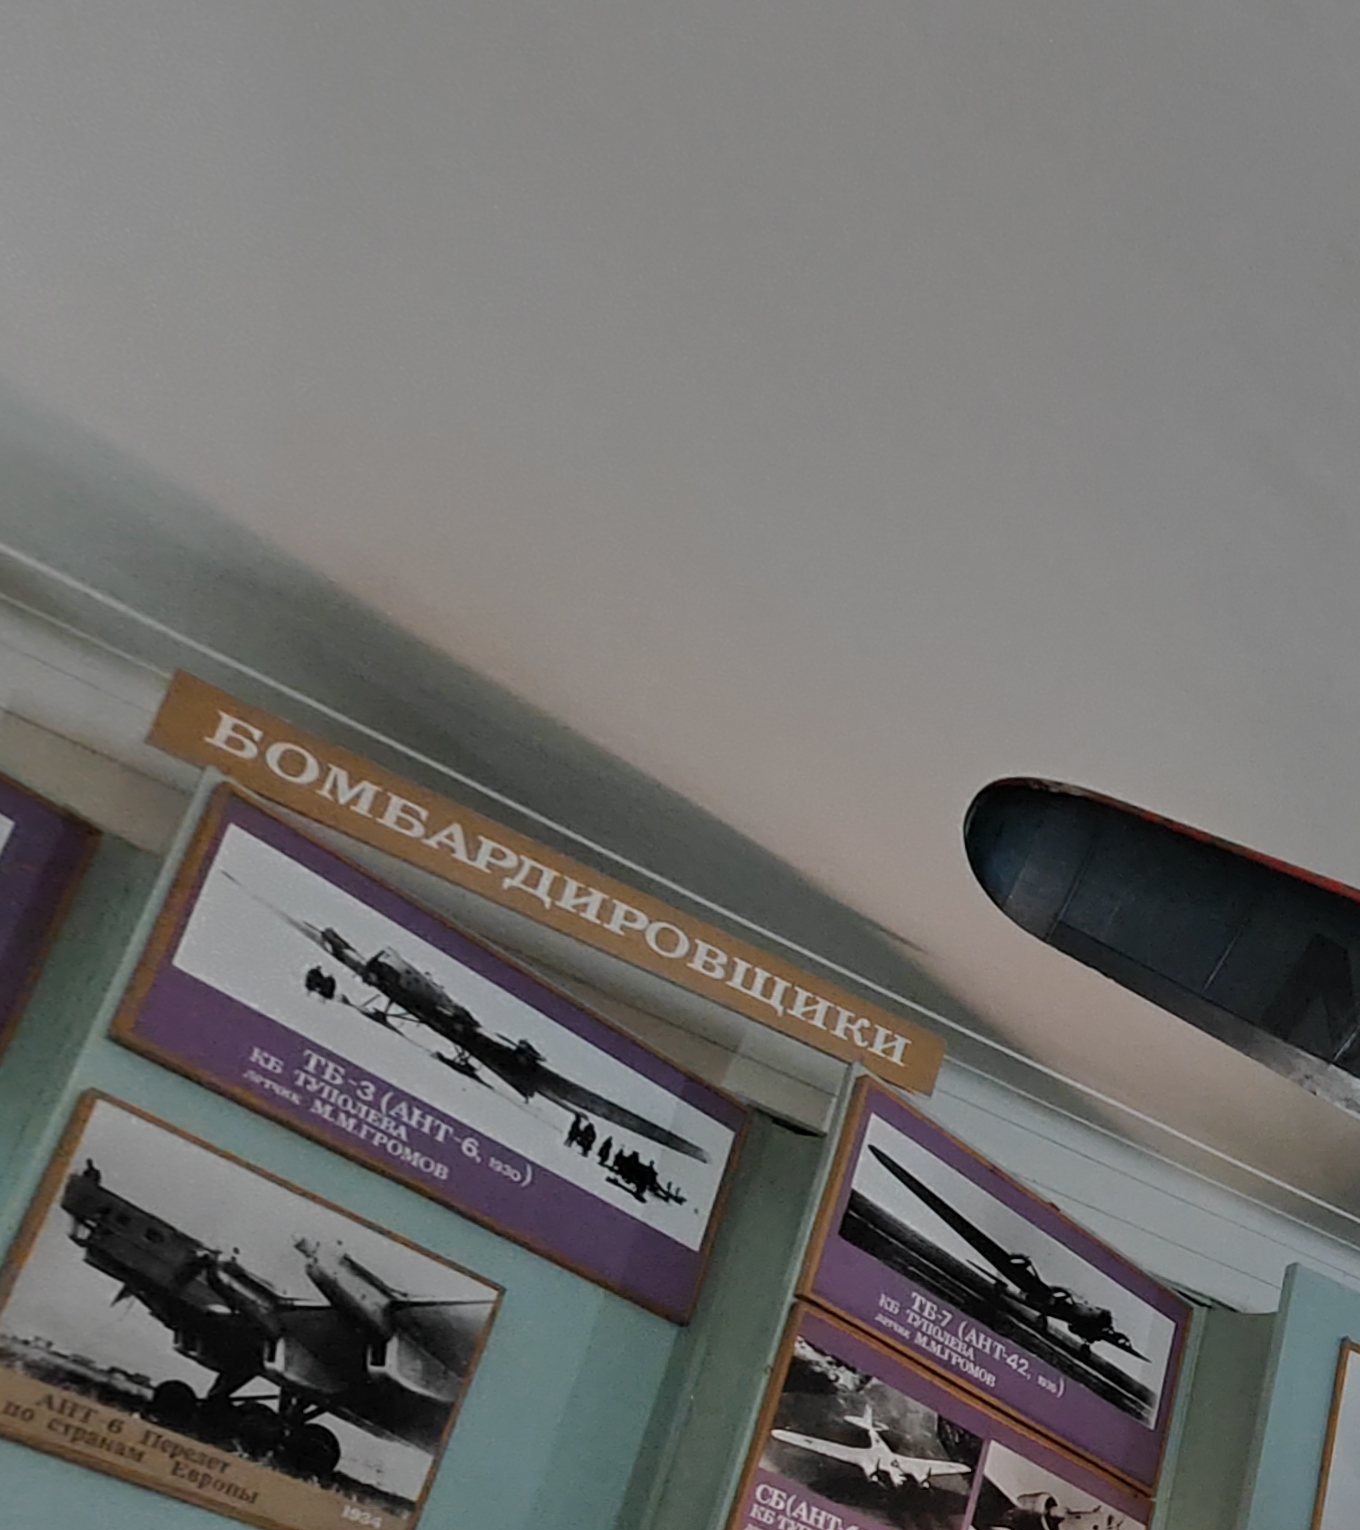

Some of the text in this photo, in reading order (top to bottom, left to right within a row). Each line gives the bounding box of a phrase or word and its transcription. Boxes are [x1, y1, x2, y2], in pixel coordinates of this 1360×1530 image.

[204, 710, 913, 1068] БОМБАРДИРОВЩИКИ
[249, 1047, 409, 1142] КБ ТУПОЛЕВА
[303, 1049, 377, 1102] ТБ-3
[380, 1091, 482, 1163] (АНТ-6,
[310, 1101, 450, 1181] М.М.ГРОМОВ
[879, 1293, 976, 1360] КБ ТУПОЛЕВА
[911, 1292, 953, 1328] ТБ-7
[957, 1321, 1032, 1380] (АНТ-42,
[47, 1415, 146, 1463] странам
[171, 1460, 260, 1504] Европы
[141, 1430, 231, 1474] Перелет
[341, 1504, 383, 1530] 1934
[750, 1503, 775, 1525] КБ
